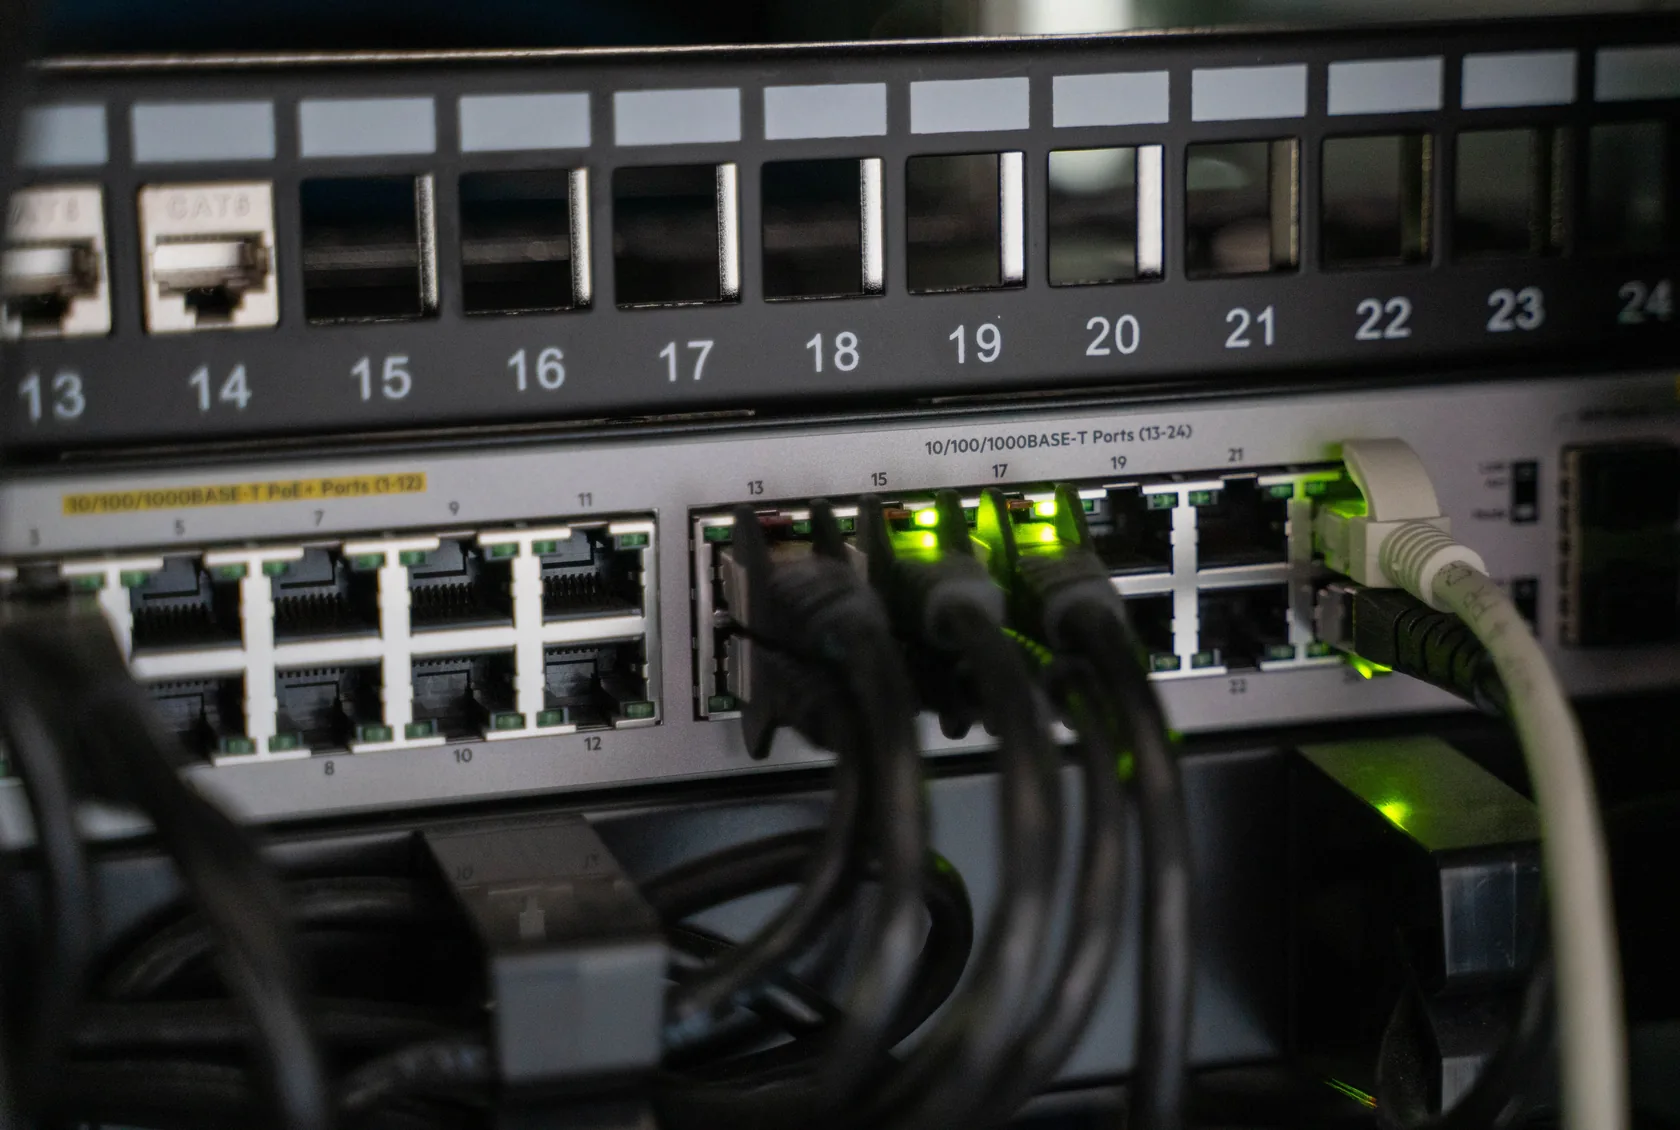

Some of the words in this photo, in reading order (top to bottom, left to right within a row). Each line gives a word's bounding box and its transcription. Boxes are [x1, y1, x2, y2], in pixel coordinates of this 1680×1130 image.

[1354, 297, 1412, 340] 22
[1486, 286, 1545, 332] 23
[1617, 280, 1672, 325] 24
[948, 323, 1001, 364] 19
[1085, 314, 1140, 357] 20
[1224, 306, 1274, 348] 21
[507, 347, 566, 392] 16
[658, 340, 714, 382] 17
[806, 331, 860, 373] 18
[188, 364, 252, 411] 14
[350, 355, 413, 401] 15
[19, 372, 86, 421] 13
[925, 430, 1088, 456] 10/100/1000BASE-T
[1092, 429, 1135, 444] Ports
[1139, 423, 1193, 442] (13-24)
[1228, 447, 1245, 462] 21
[871, 472, 888, 487] 15
[992, 463, 1009, 478] 17
[1110, 455, 1128, 470] 19
[68, 484, 262, 513] 10/100/1000BASE-T
[267, 480, 316, 500] PoE+
[320, 477, 370, 496] Ports
[374, 473, 423, 494] (1-12)
[578, 492, 593, 507] 11
[747, 480, 764, 495] 13
[313, 508, 325, 527] 7
[448, 501, 460, 516] 9
[174, 518, 186, 536] 5
[453, 748, 473, 763] 10
[584, 736, 602, 752] 12
[324, 760, 336, 776] 8
